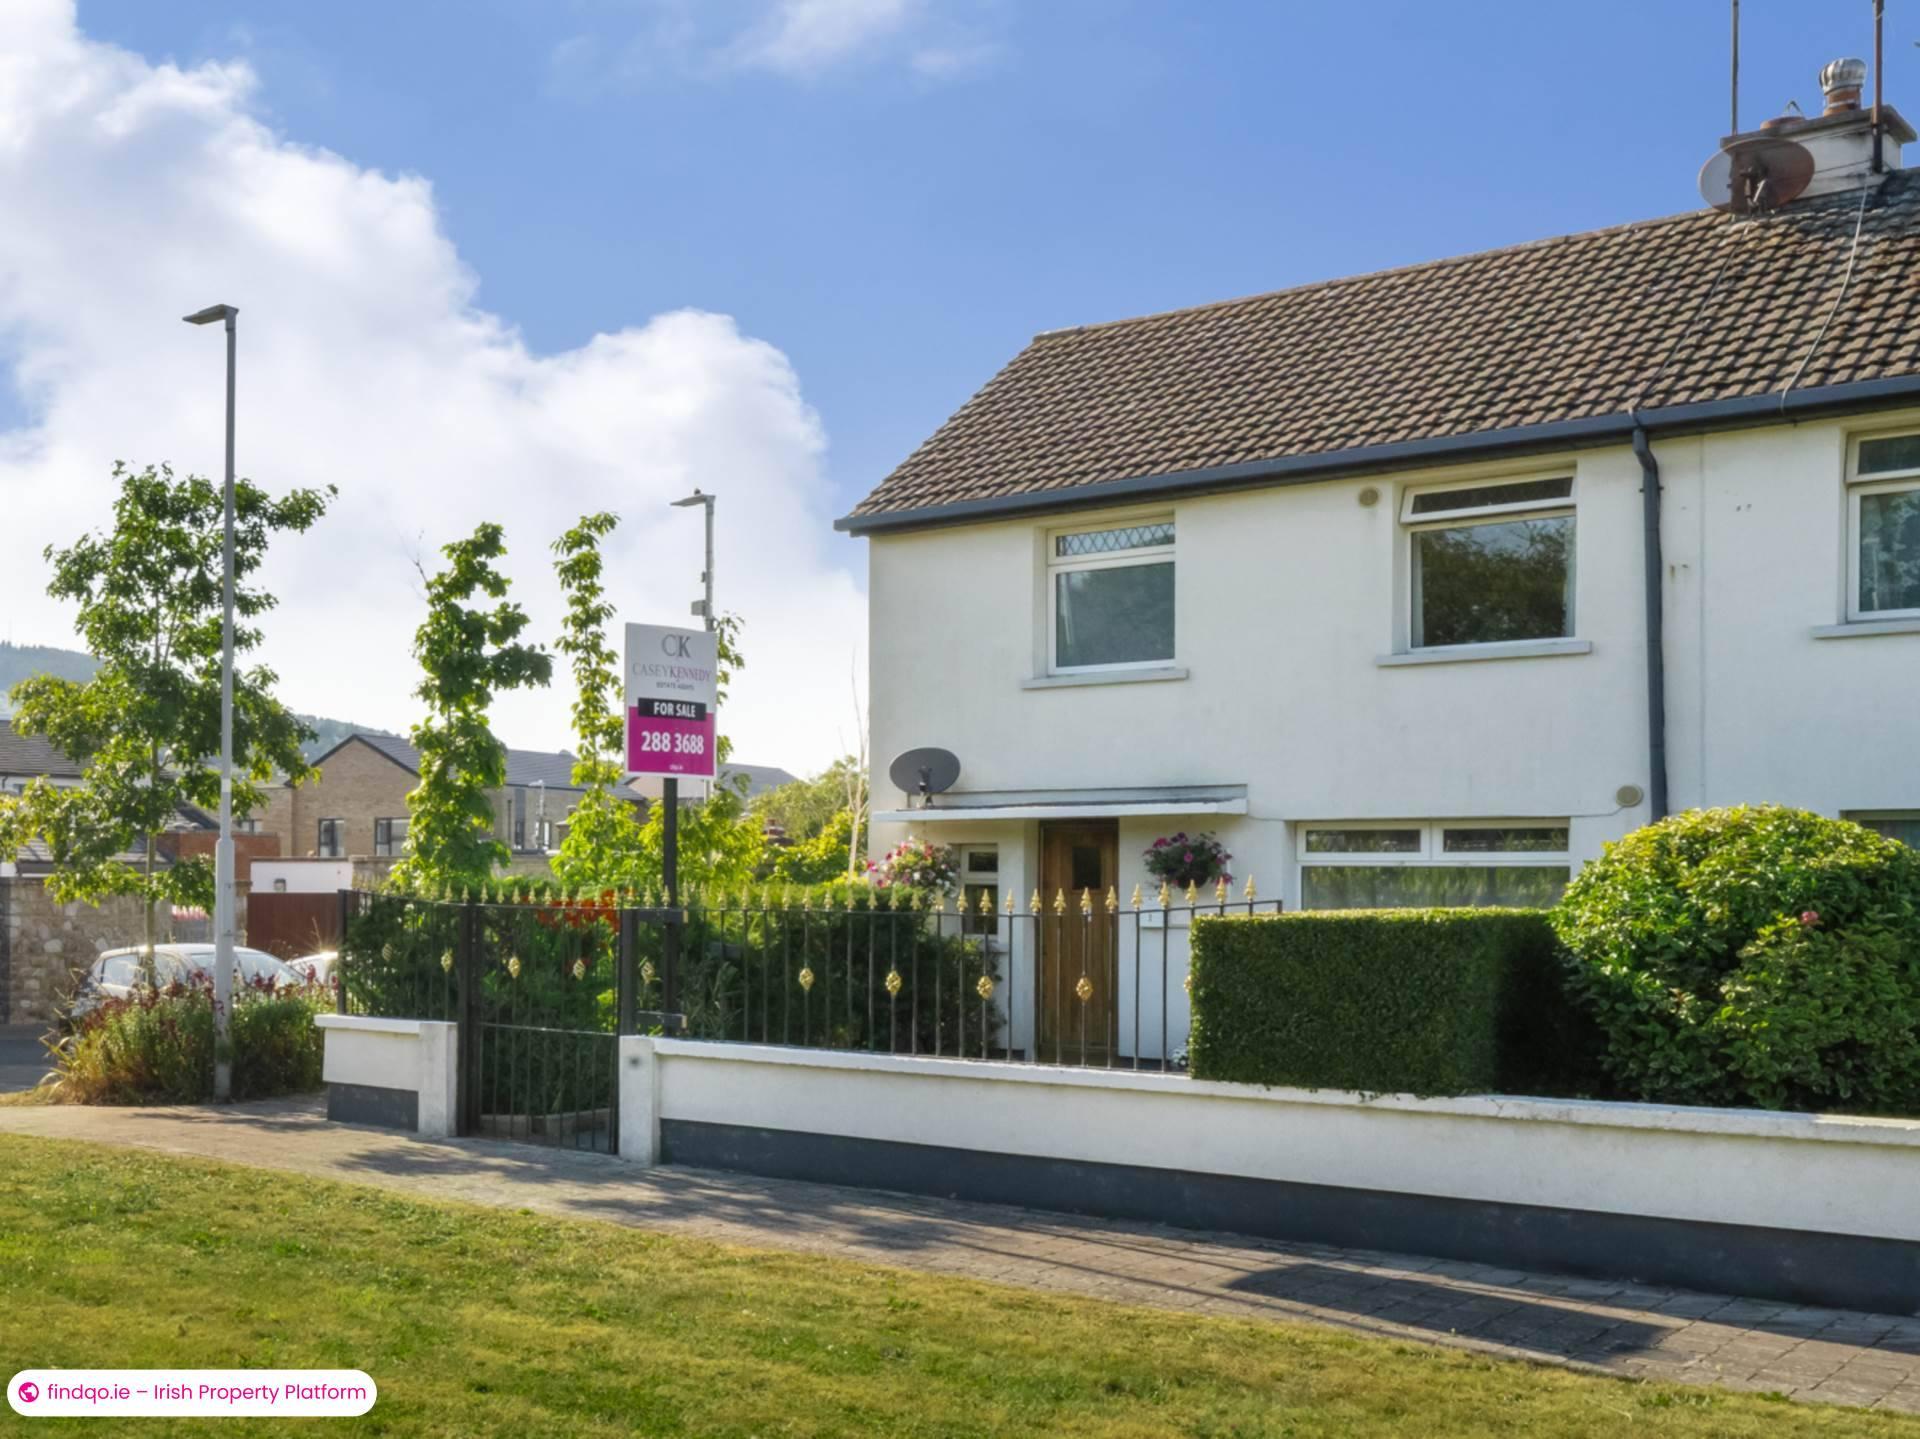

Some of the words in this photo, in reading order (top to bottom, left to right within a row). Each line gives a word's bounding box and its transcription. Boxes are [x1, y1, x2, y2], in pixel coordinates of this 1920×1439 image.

[662, 634, 691, 658] CK
[653, 702, 674, 716] FOR
[676, 704, 696, 718] SALE
[641, 731, 671, 752] 288
[674, 733, 704, 755] 3688
